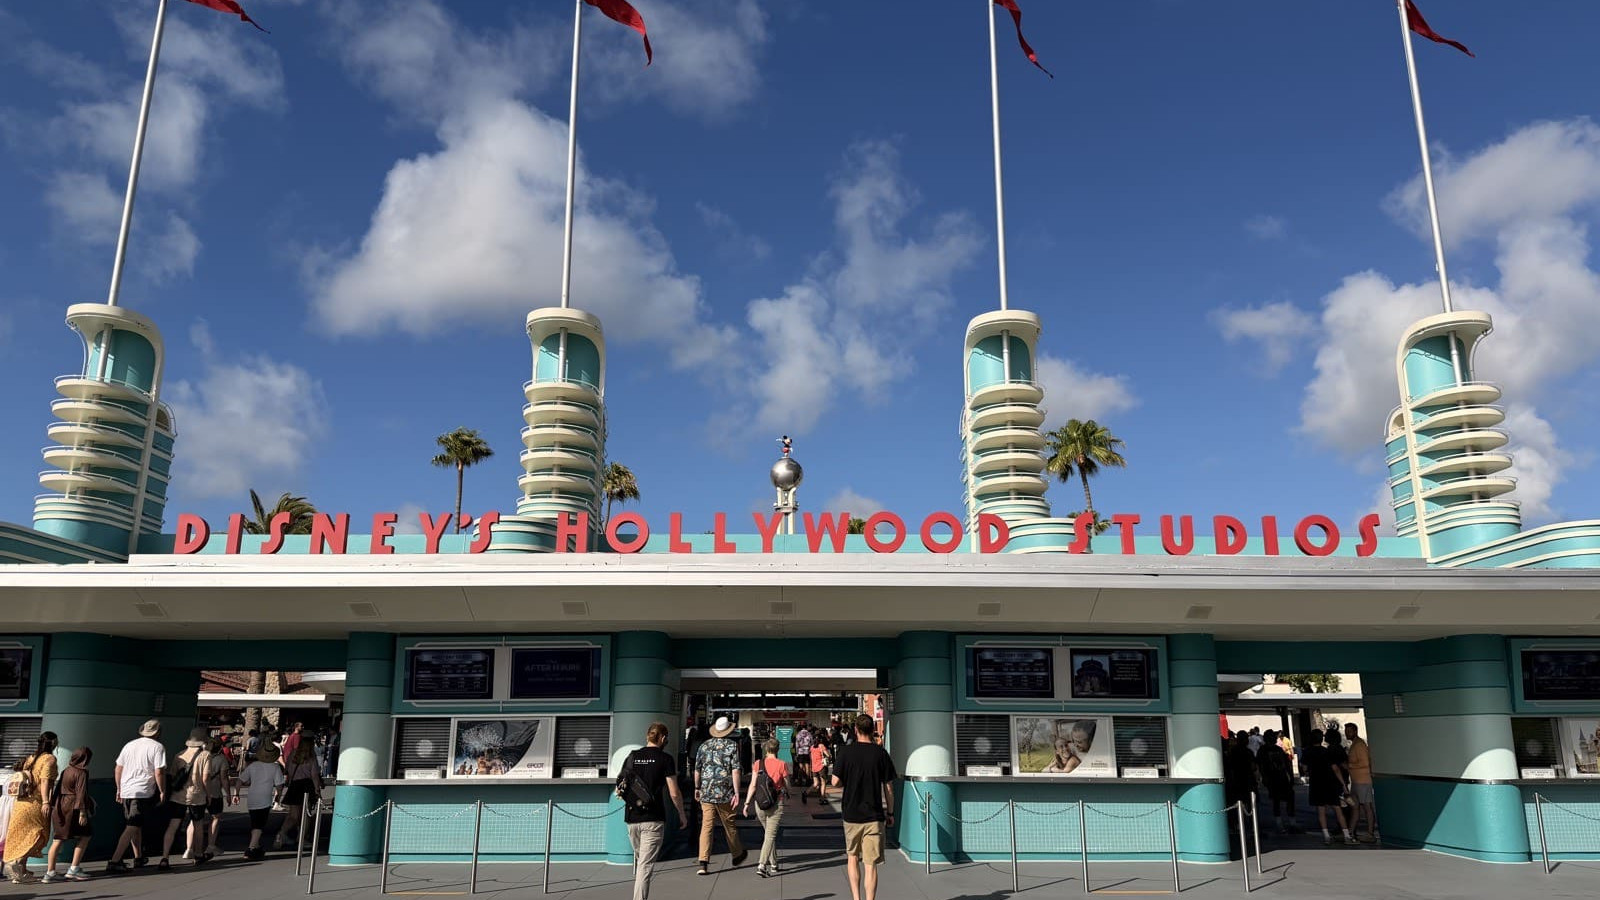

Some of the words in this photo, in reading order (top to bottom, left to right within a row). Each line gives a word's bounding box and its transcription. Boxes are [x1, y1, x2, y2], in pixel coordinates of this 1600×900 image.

[175, 512, 501, 554] DISNEY'S
[555, 511, 1011, 554] HOLLYWOOD
[1069, 511, 1381, 556] STUDIOS
[524, 663, 551, 672] AFTER
